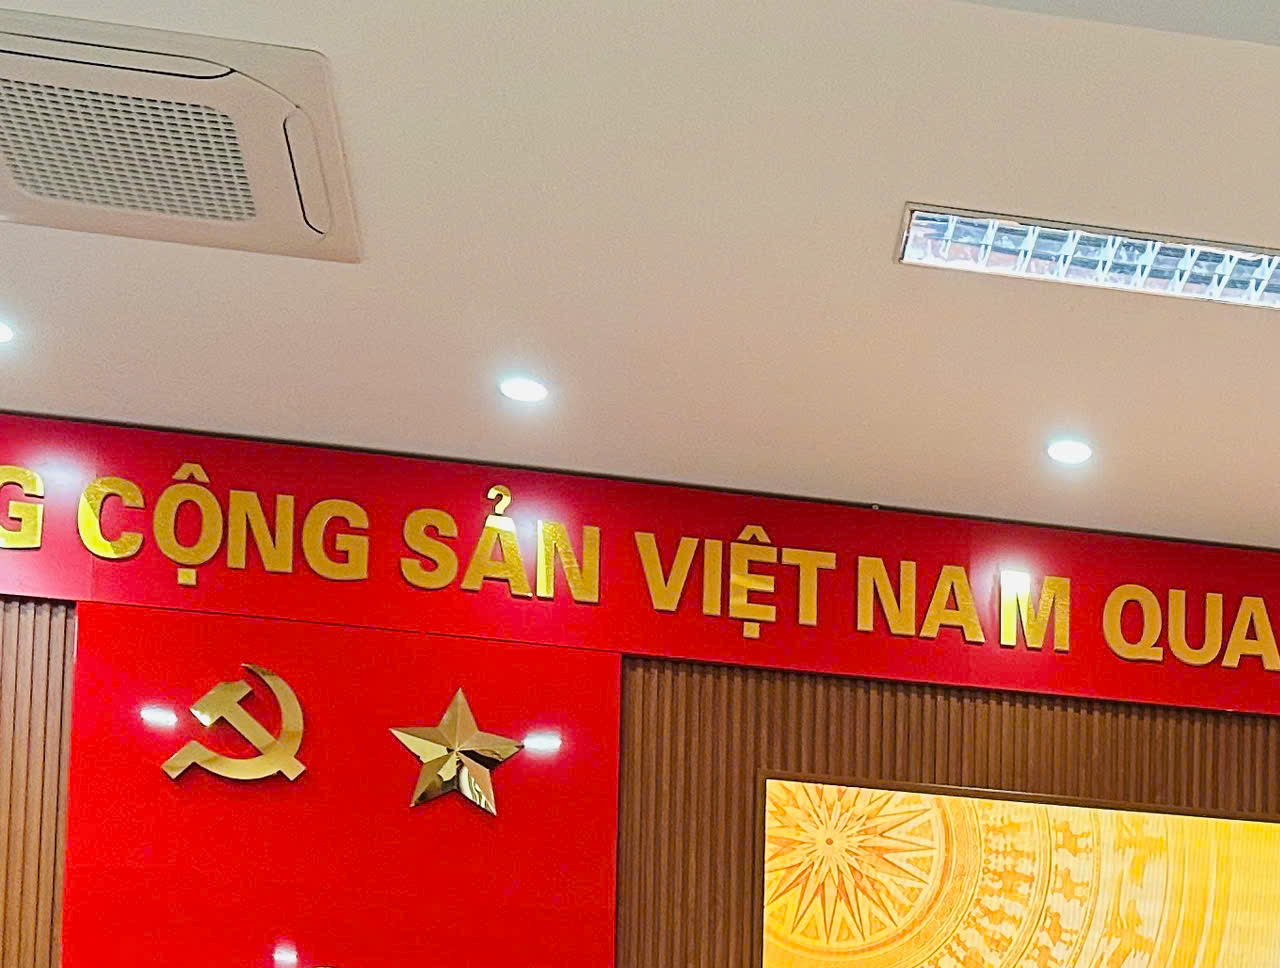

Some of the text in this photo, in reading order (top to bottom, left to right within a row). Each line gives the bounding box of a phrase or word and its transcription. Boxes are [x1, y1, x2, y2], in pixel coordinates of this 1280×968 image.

[77, 462, 369, 586] CỘNG
[399, 484, 600, 604] SẢN
[634, 525, 836, 639] VIỆT
[856, 556, 1072, 653] NAM
